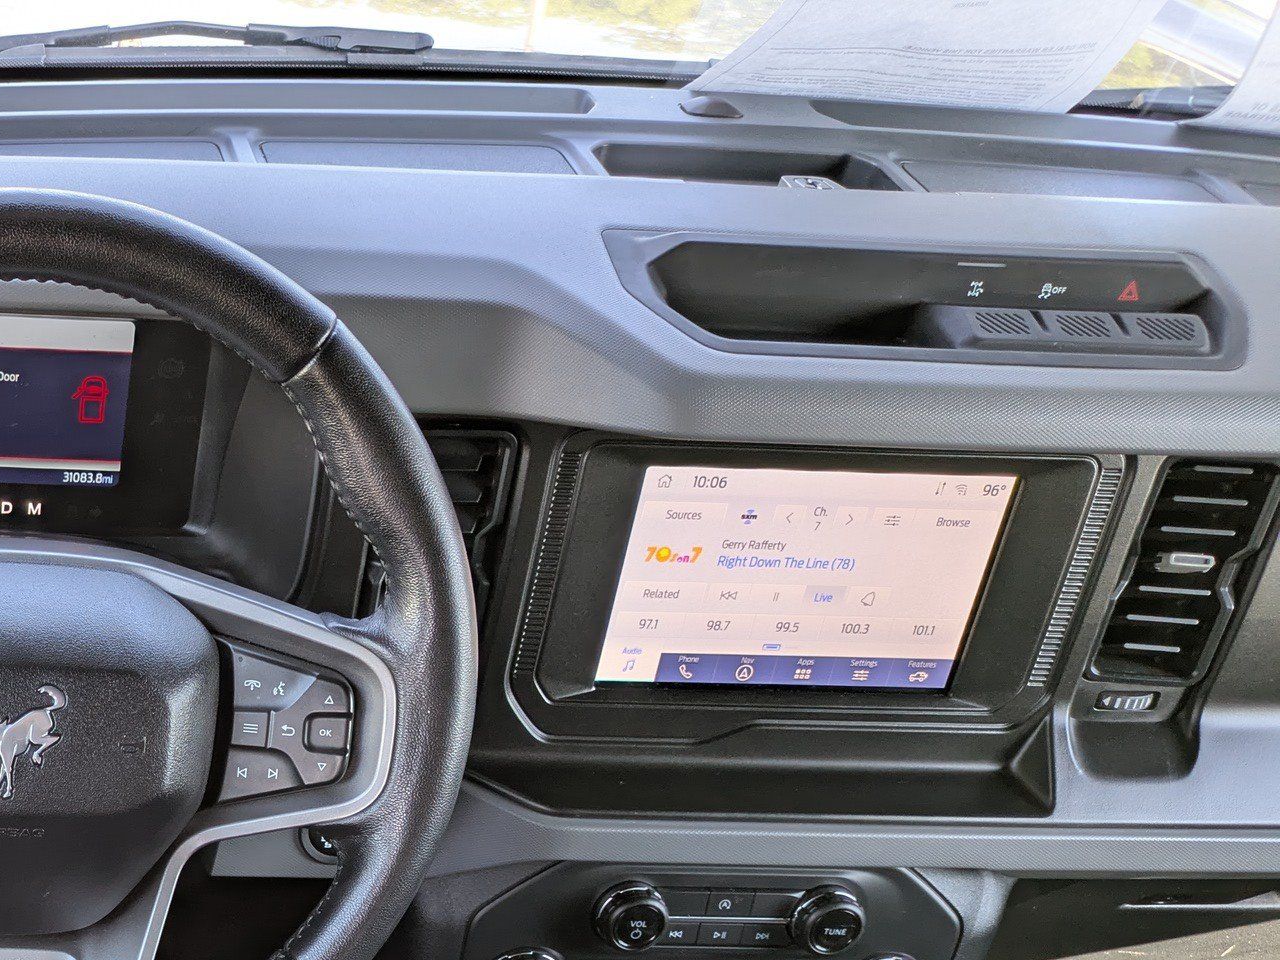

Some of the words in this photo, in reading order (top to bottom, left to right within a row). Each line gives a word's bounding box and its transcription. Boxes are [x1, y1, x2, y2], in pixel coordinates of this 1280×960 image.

[62, 471, 113, 485] 31083.8mi
[693, 475, 728, 490] 10:06
[982, 483, 1007, 498] 96°
[1, 501, 13, 515] D
[27, 502, 42, 516] M
[814, 506, 828, 517] Ch.
[665, 510, 702, 521] Sources
[814, 521, 821, 531] 7
[935, 516, 971, 529] Browse
[721, 539, 747, 551] Gerry
[748, 540, 787, 552] Rafferty
[717, 555, 747, 570] Right
[749, 556, 780, 569] Down
[784, 557, 804, 569] The
[805, 557, 829, 570] Line
[831, 558, 856, 571] (78)
[643, 588, 680, 600] Related
[814, 592, 834, 603] Live
[638, 618, 659, 630] 97.1
[706, 620, 731, 631] 98.7
[775, 621, 800, 633] 99.5
[840, 623, 870, 635] 100.3
[911, 624, 936, 636] 101.1
[621, 646, 643, 656] Audio
[677, 655, 700, 665] Phone
[740, 656, 755, 665] Nav
[797, 657, 815, 667] Apps
[850, 658, 879, 669] Settings
[907, 659, 937, 670] Features
[319, 729, 333, 738] OK
[630, 919, 647, 929] VOL
[823, 926, 848, 937] TUNE
